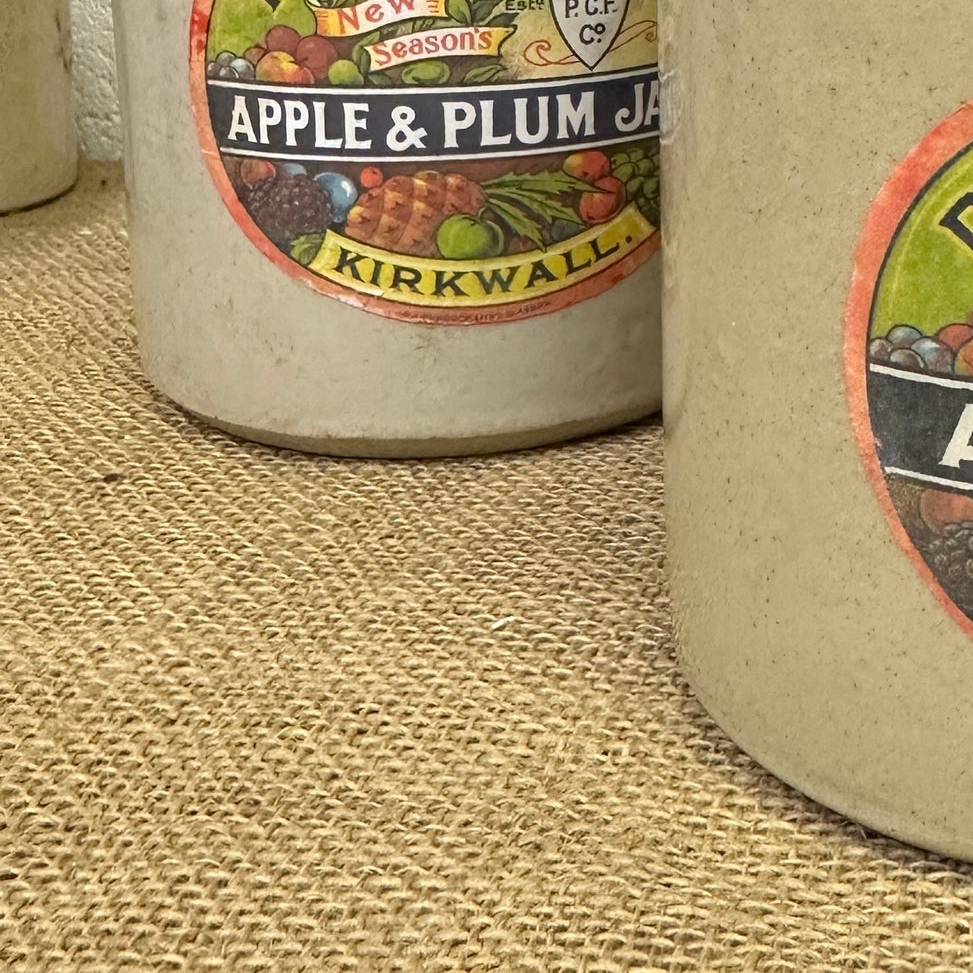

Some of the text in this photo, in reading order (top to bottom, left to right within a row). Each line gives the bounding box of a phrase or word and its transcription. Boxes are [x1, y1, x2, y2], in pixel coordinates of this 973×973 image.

[372, 27, 494, 67] Season's
[227, 80, 659, 151] APPLE & PLUM JA
